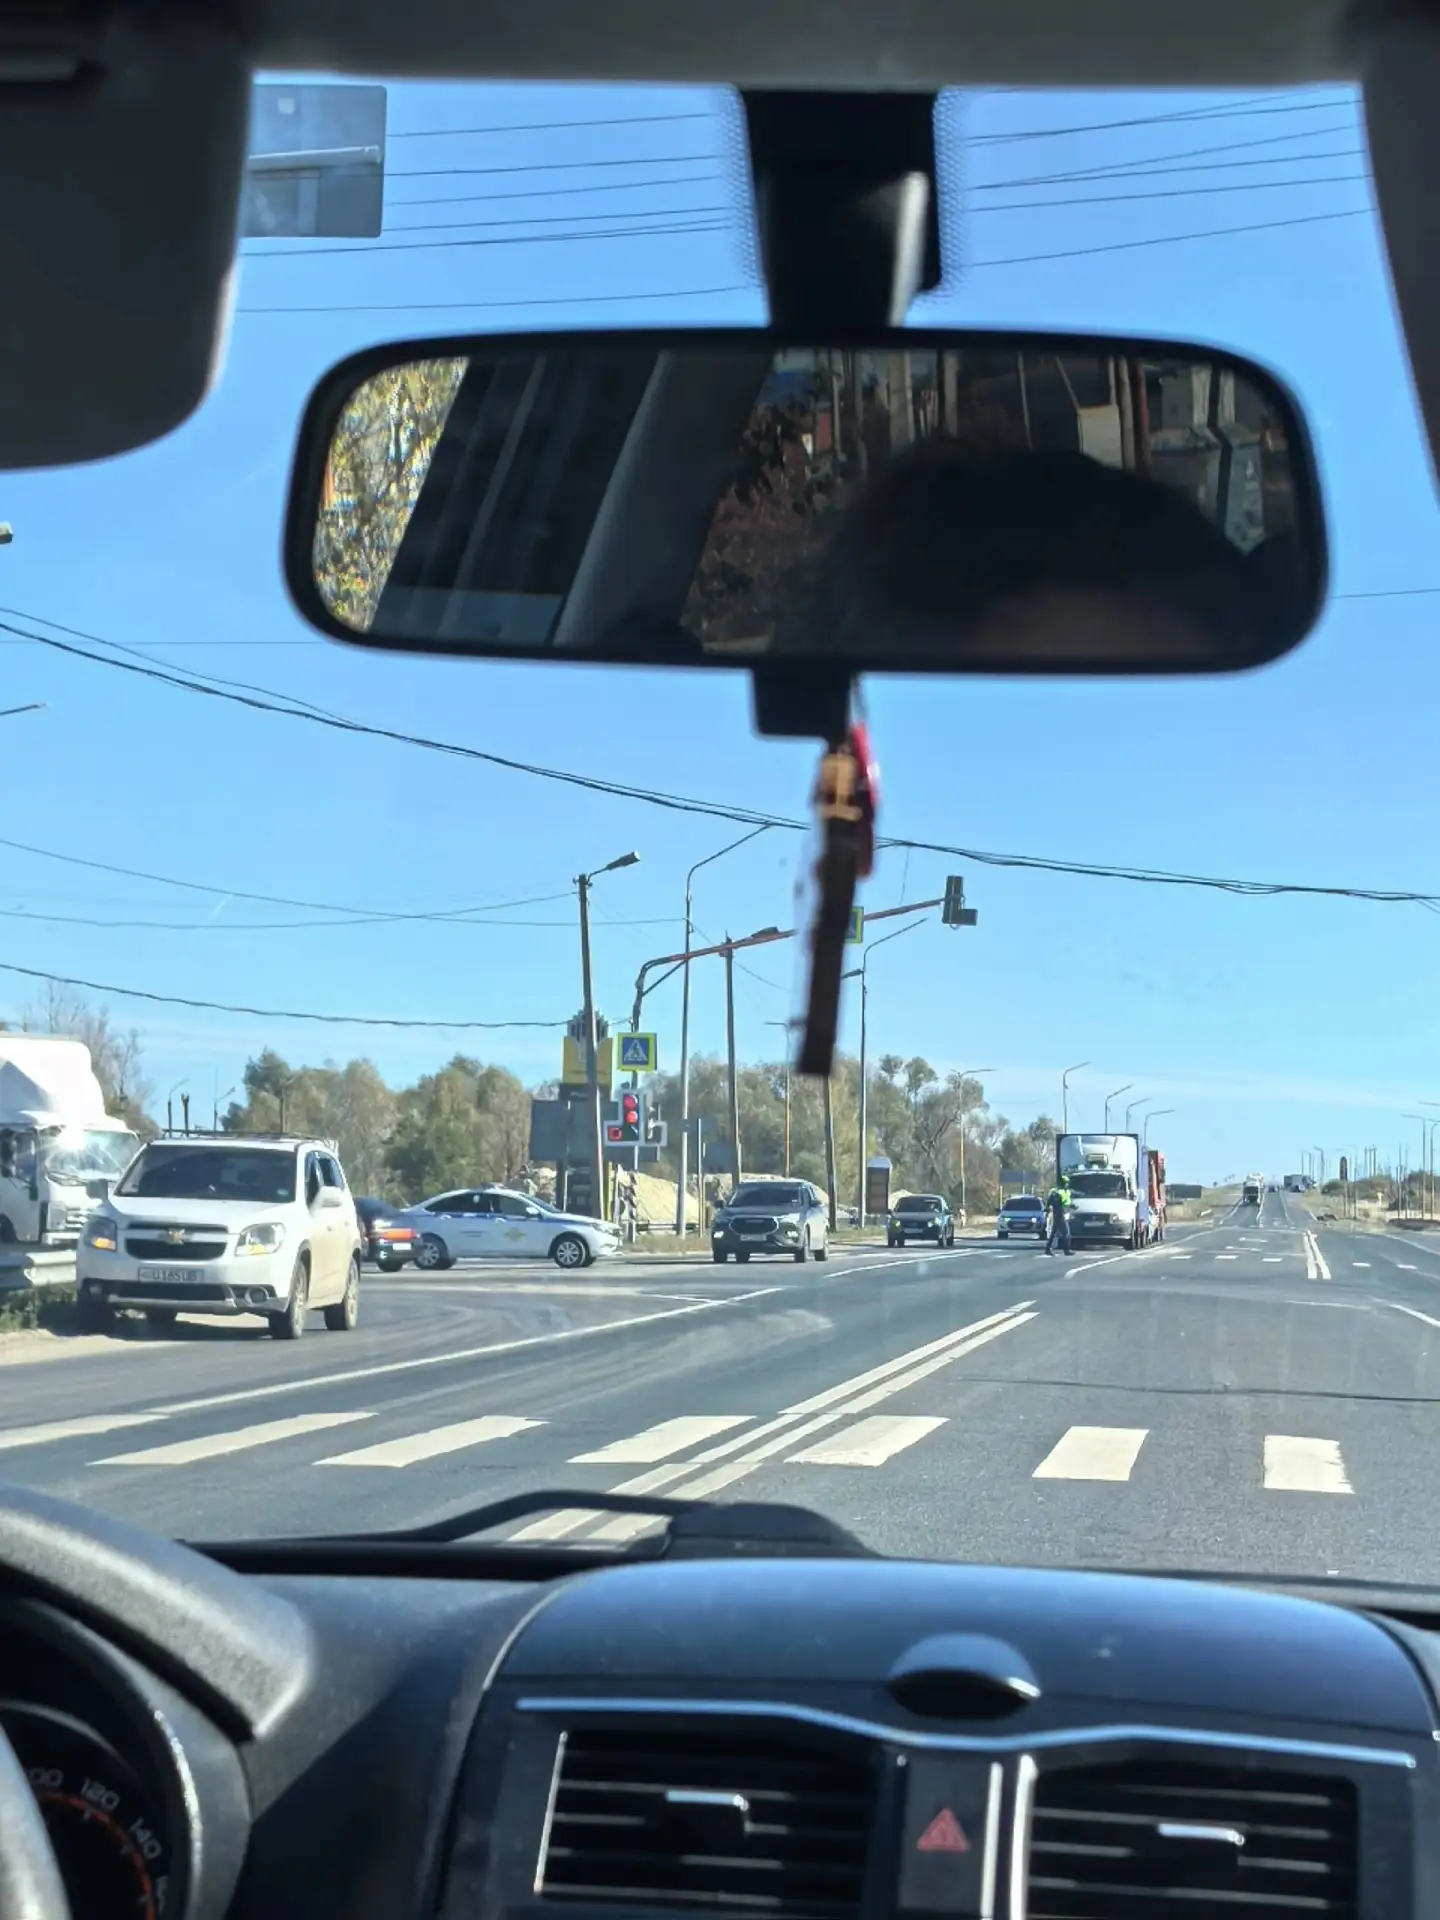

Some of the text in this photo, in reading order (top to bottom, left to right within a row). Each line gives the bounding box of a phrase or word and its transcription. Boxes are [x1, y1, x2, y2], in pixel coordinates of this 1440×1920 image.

[29, 1767, 64, 1788] 00
[81, 1777, 120, 1812] 120
[130, 1816, 162, 1860] 140
